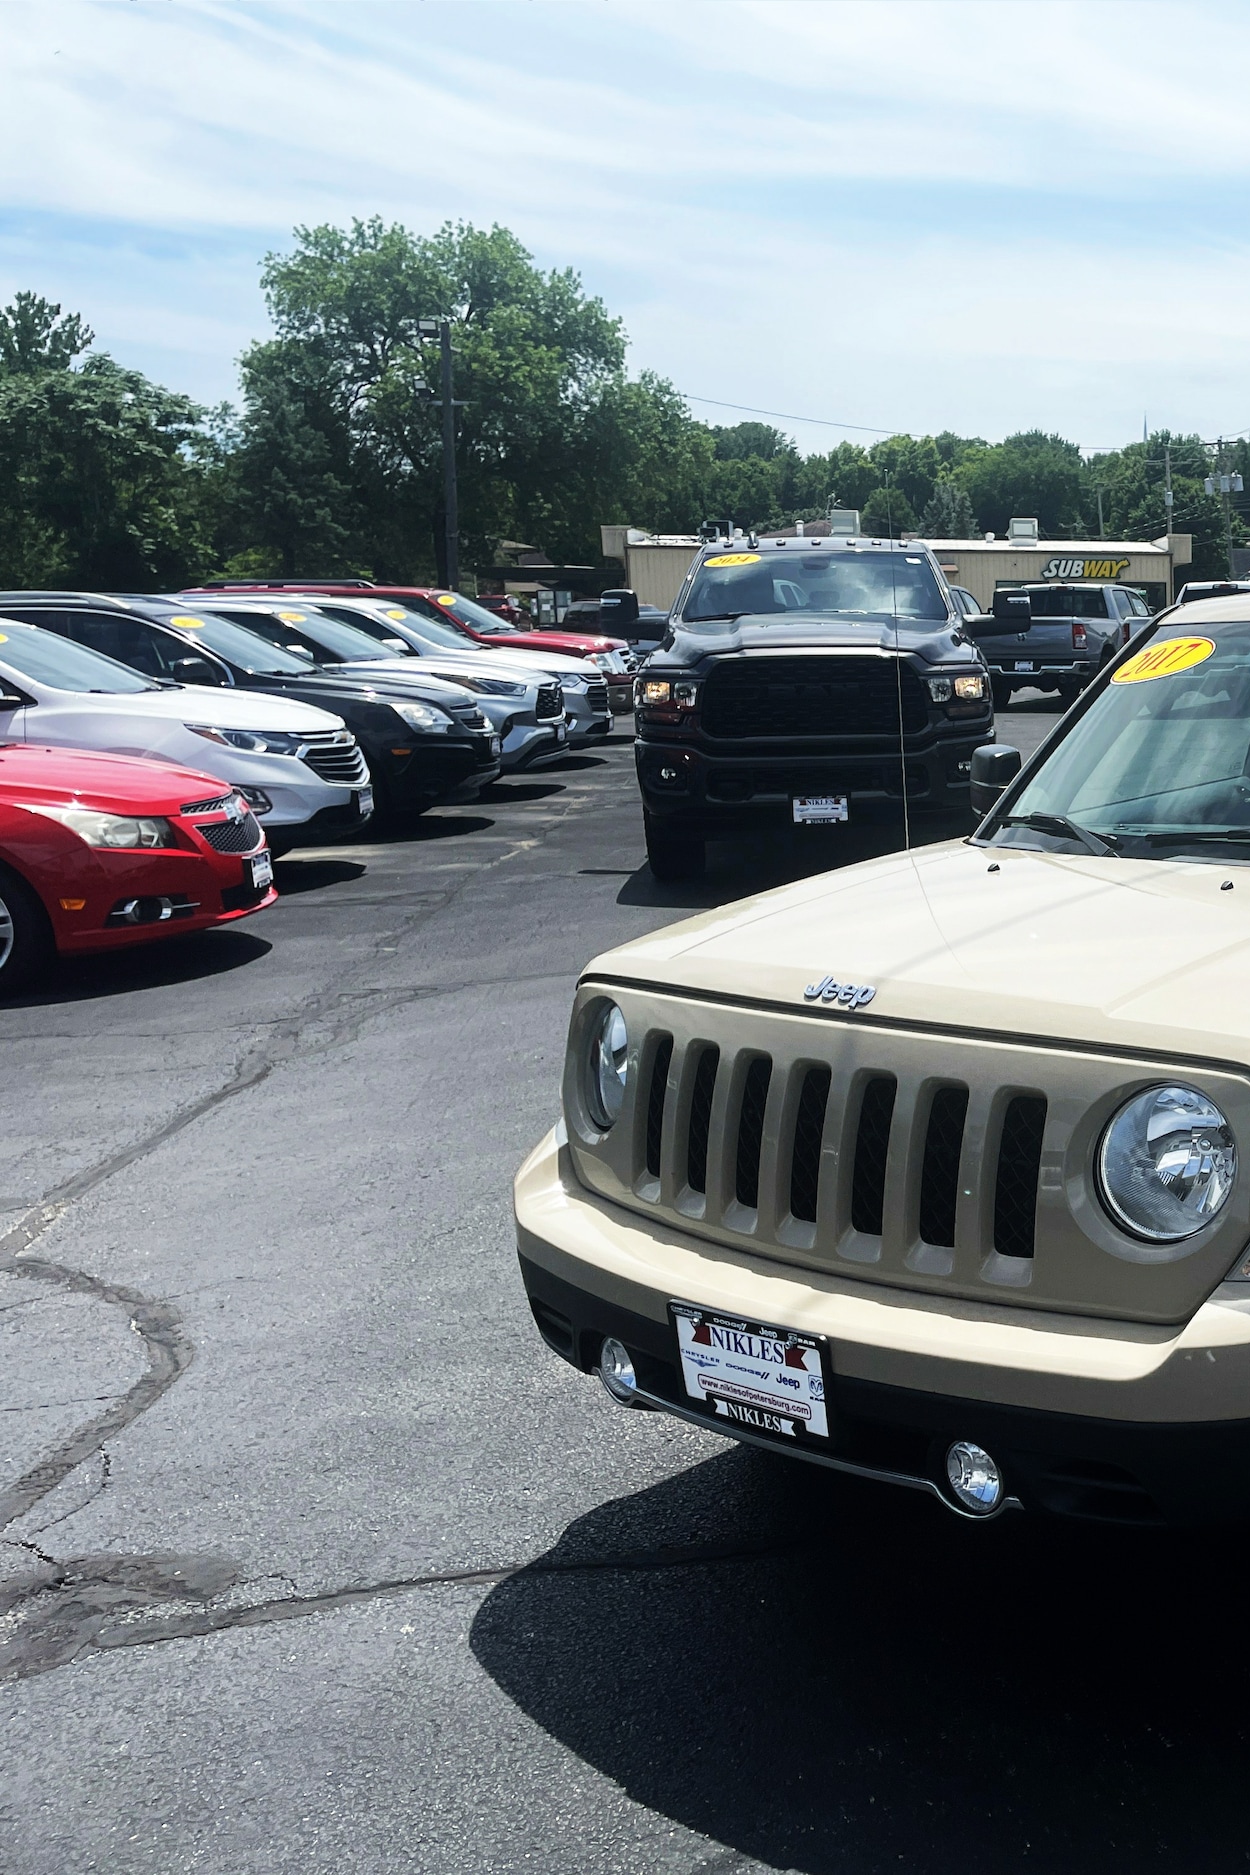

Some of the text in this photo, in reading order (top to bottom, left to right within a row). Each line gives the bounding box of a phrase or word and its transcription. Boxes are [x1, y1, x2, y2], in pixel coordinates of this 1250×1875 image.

[711, 555, 750, 566] 2024
[1043, 558, 1130, 579] SUBWAY
[1118, 643, 1203, 679] 2017
[804, 975, 877, 1009] Jeep
[711, 1326, 784, 1364] NIKLES
[759, 1327, 777, 1339] Jeep
[798, 1338, 816, 1347] RAM
[681, 1348, 720, 1363] CHRYSLER
[776, 1373, 800, 1390] Jeep
[701, 1378, 809, 1415] www.niklesofpetersburg.com
[727, 1402, 782, 1432] NIKLES
